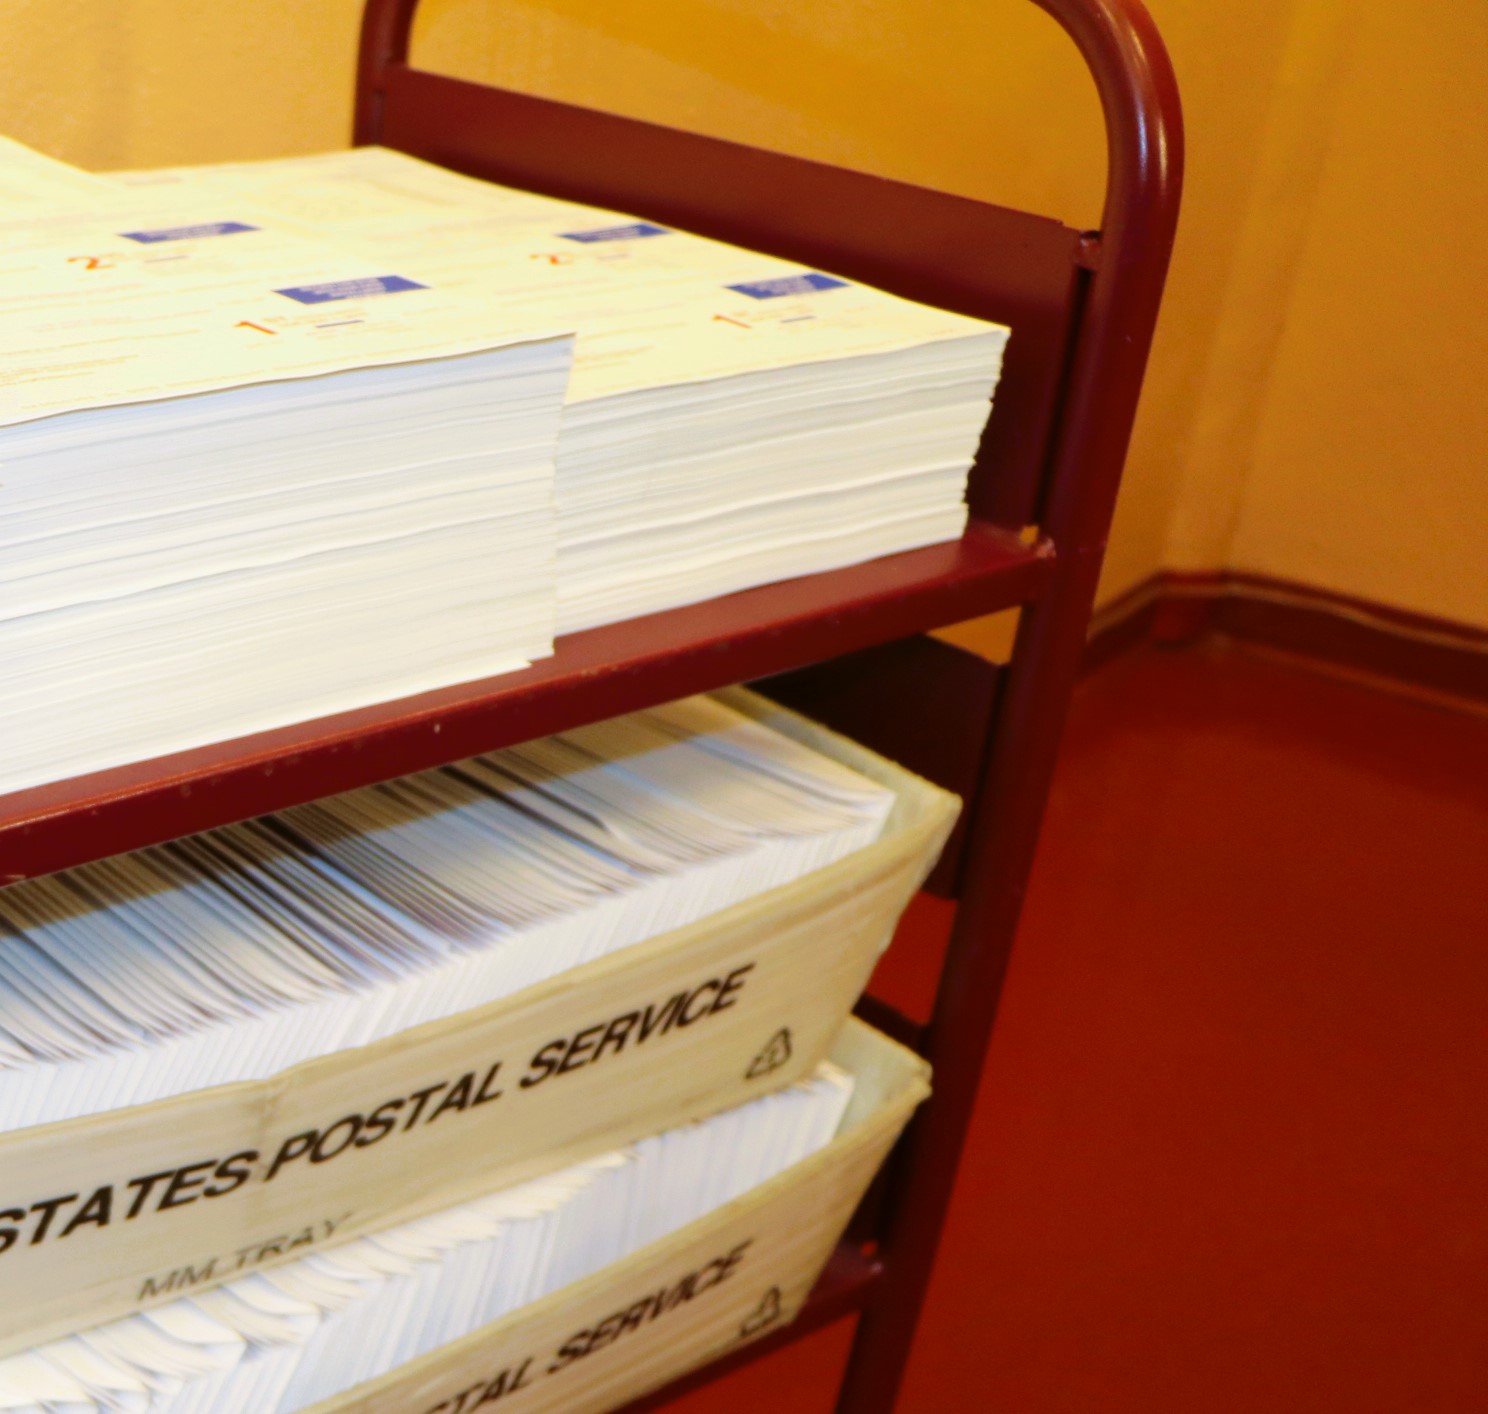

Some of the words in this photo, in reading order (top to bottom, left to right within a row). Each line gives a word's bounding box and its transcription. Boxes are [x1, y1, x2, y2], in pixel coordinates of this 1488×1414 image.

[265, 1061, 503, 1181] POSTAL
[519, 961, 757, 1089] SERVICE
[139, 1258, 219, 1301] MM
[236, 1212, 352, 1269] TRAY
[547, 1238, 754, 1374] SERVICE
